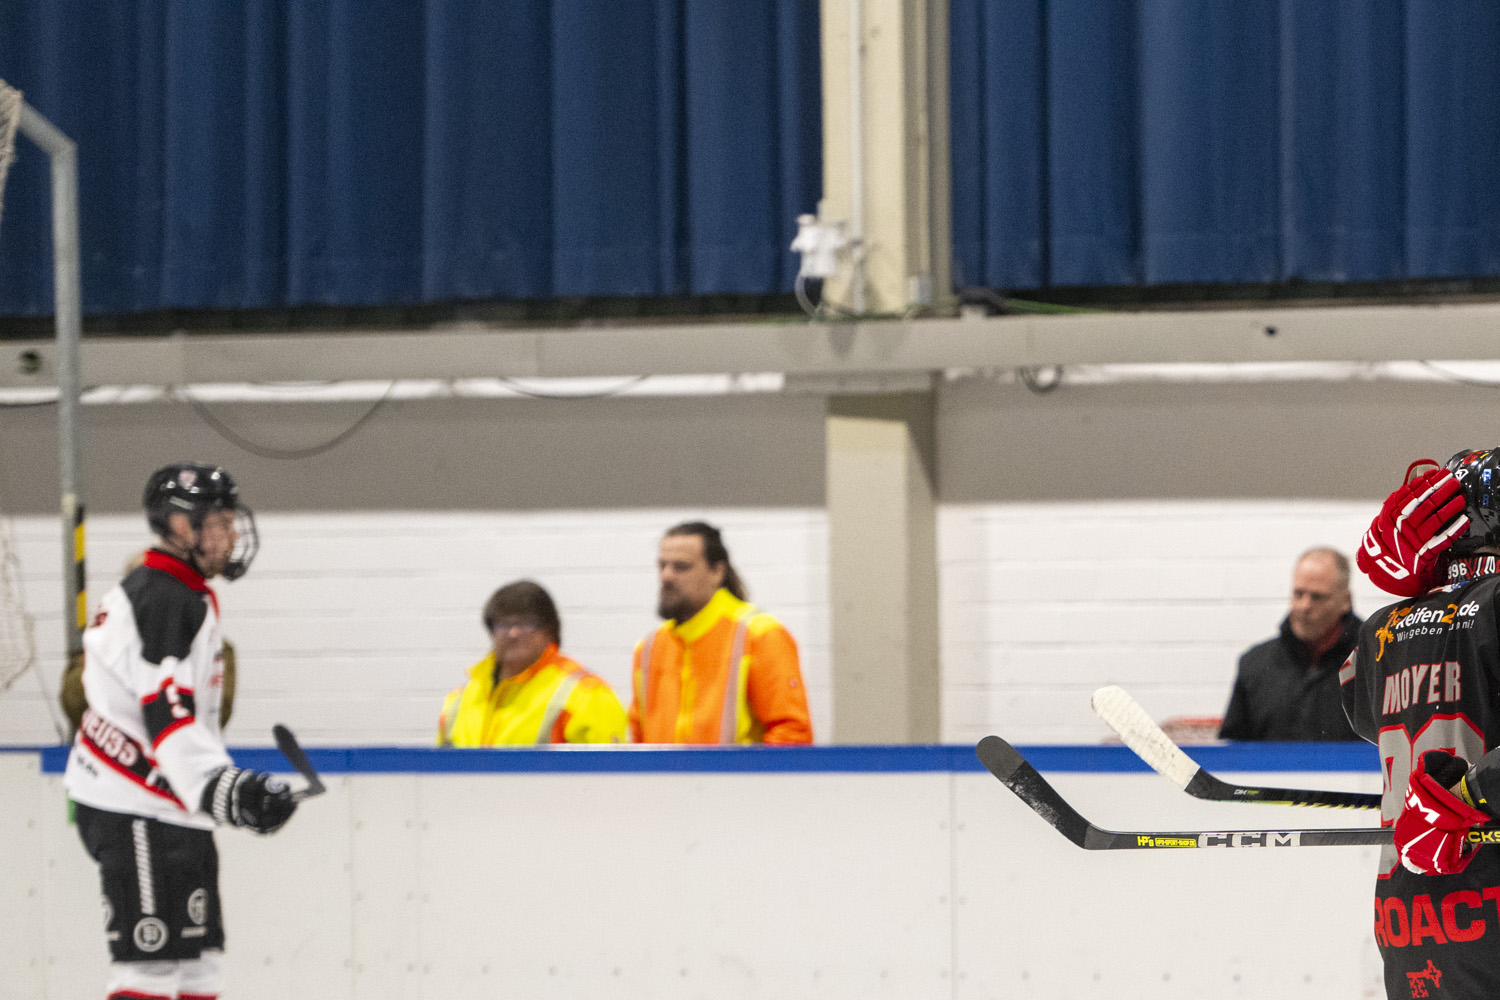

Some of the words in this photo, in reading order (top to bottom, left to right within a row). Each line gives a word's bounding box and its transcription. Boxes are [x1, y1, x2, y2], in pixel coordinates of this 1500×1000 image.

[1409, 625, 1443, 640] geben
[1381, 660, 1462, 716] MOYER
[1199, 832, 1300, 848] CCM
